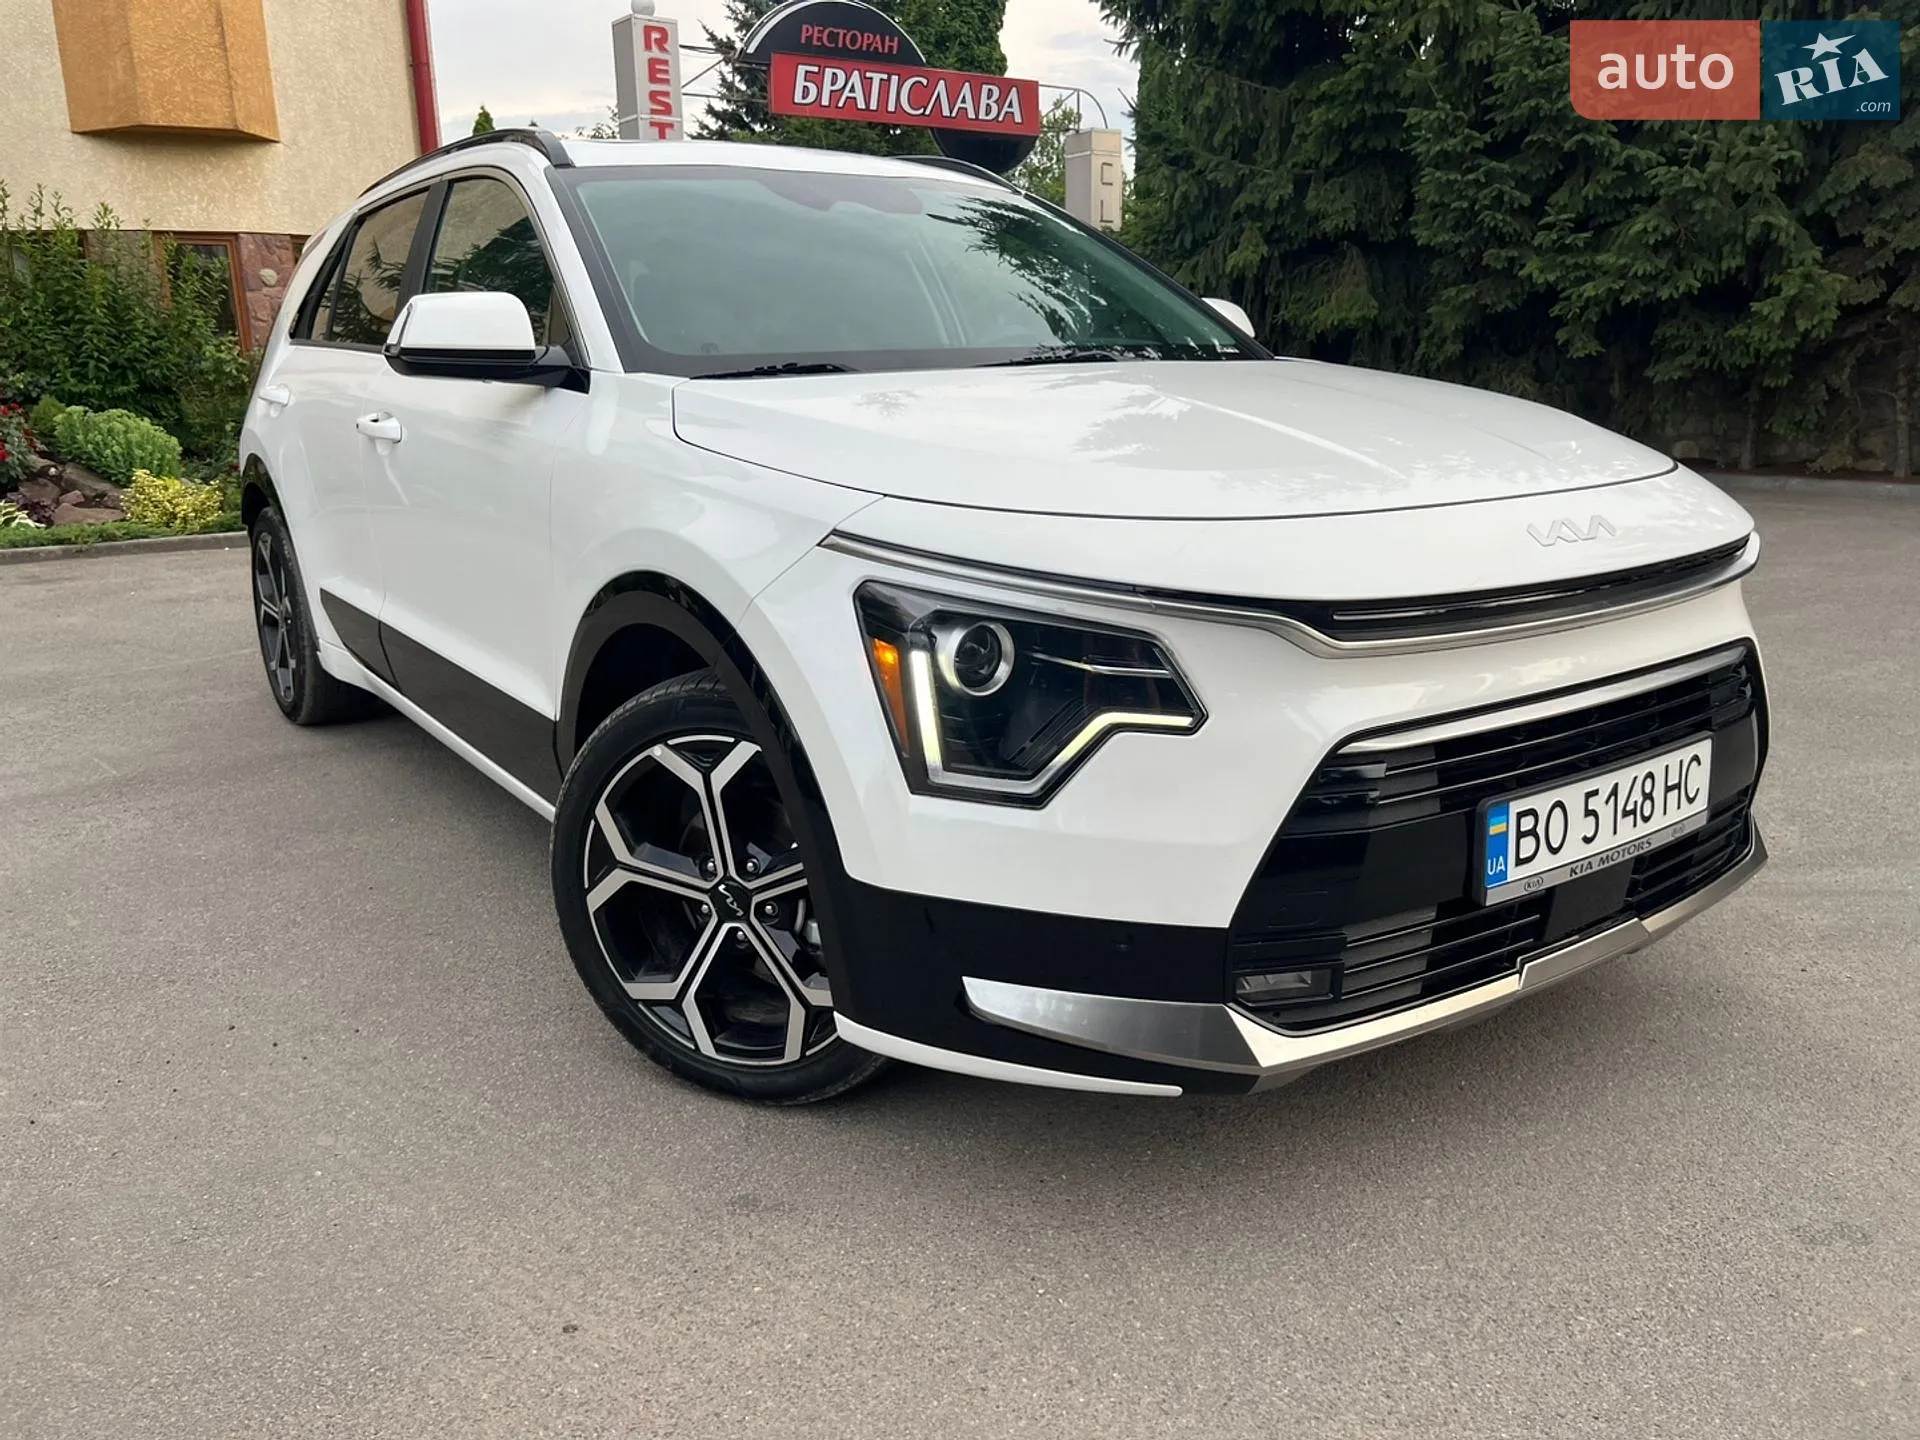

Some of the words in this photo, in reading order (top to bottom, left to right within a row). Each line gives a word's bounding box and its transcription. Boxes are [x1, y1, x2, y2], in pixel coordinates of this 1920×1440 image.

[801, 24, 898, 55] РЕСТОРАН
[643, 24, 674, 140] REST
[793, 63, 1023, 124] БРАТІСЛАВА
[1515, 799, 1568, 867] BO
[1581, 769, 1655, 844] 5148
[1663, 753, 1702, 816] HC
[1487, 855, 1506, 875] UA
[1569, 860, 1593, 877] KIA
[1597, 837, 1652, 867] MOTORS
